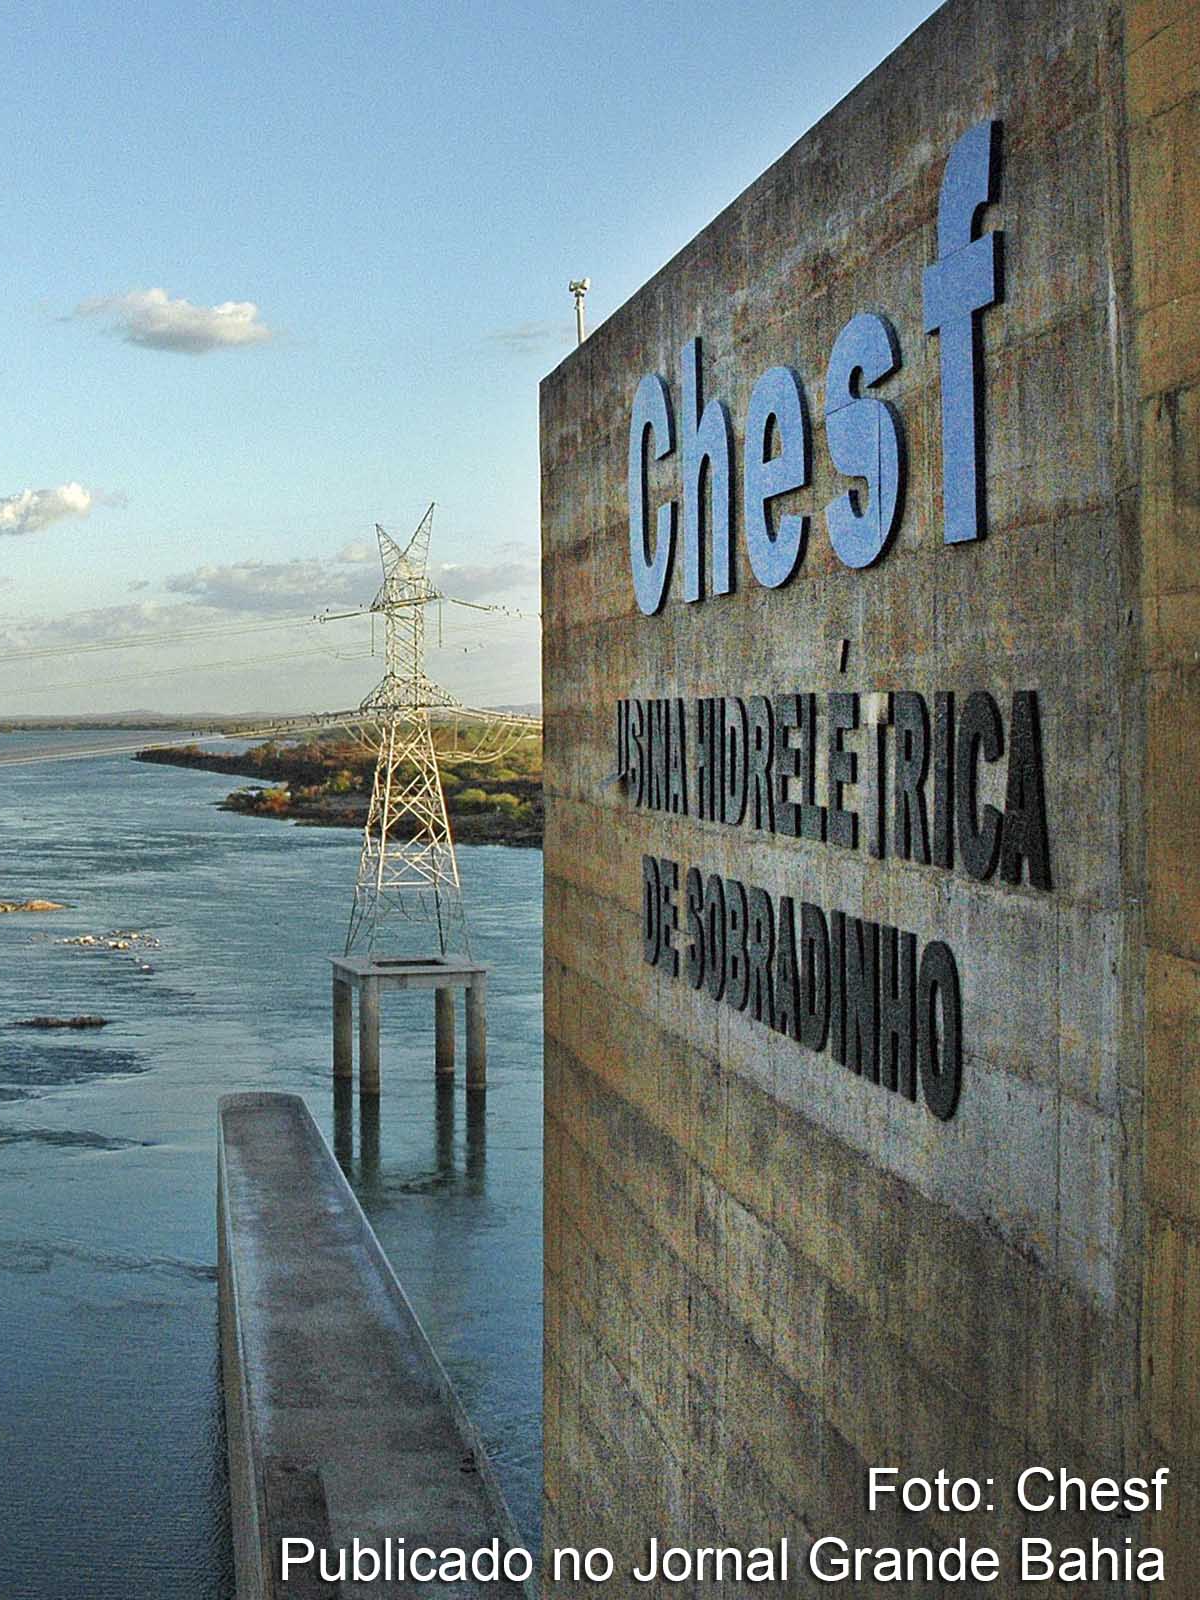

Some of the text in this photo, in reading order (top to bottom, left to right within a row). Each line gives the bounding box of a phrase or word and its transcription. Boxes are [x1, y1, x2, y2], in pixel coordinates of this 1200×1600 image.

[628, 120, 1003, 616] Chesf
[616, 639, 1053, 891] USINA HIDRELÉTRICA
[642, 854, 964, 1122] DE SOBRADINHO
